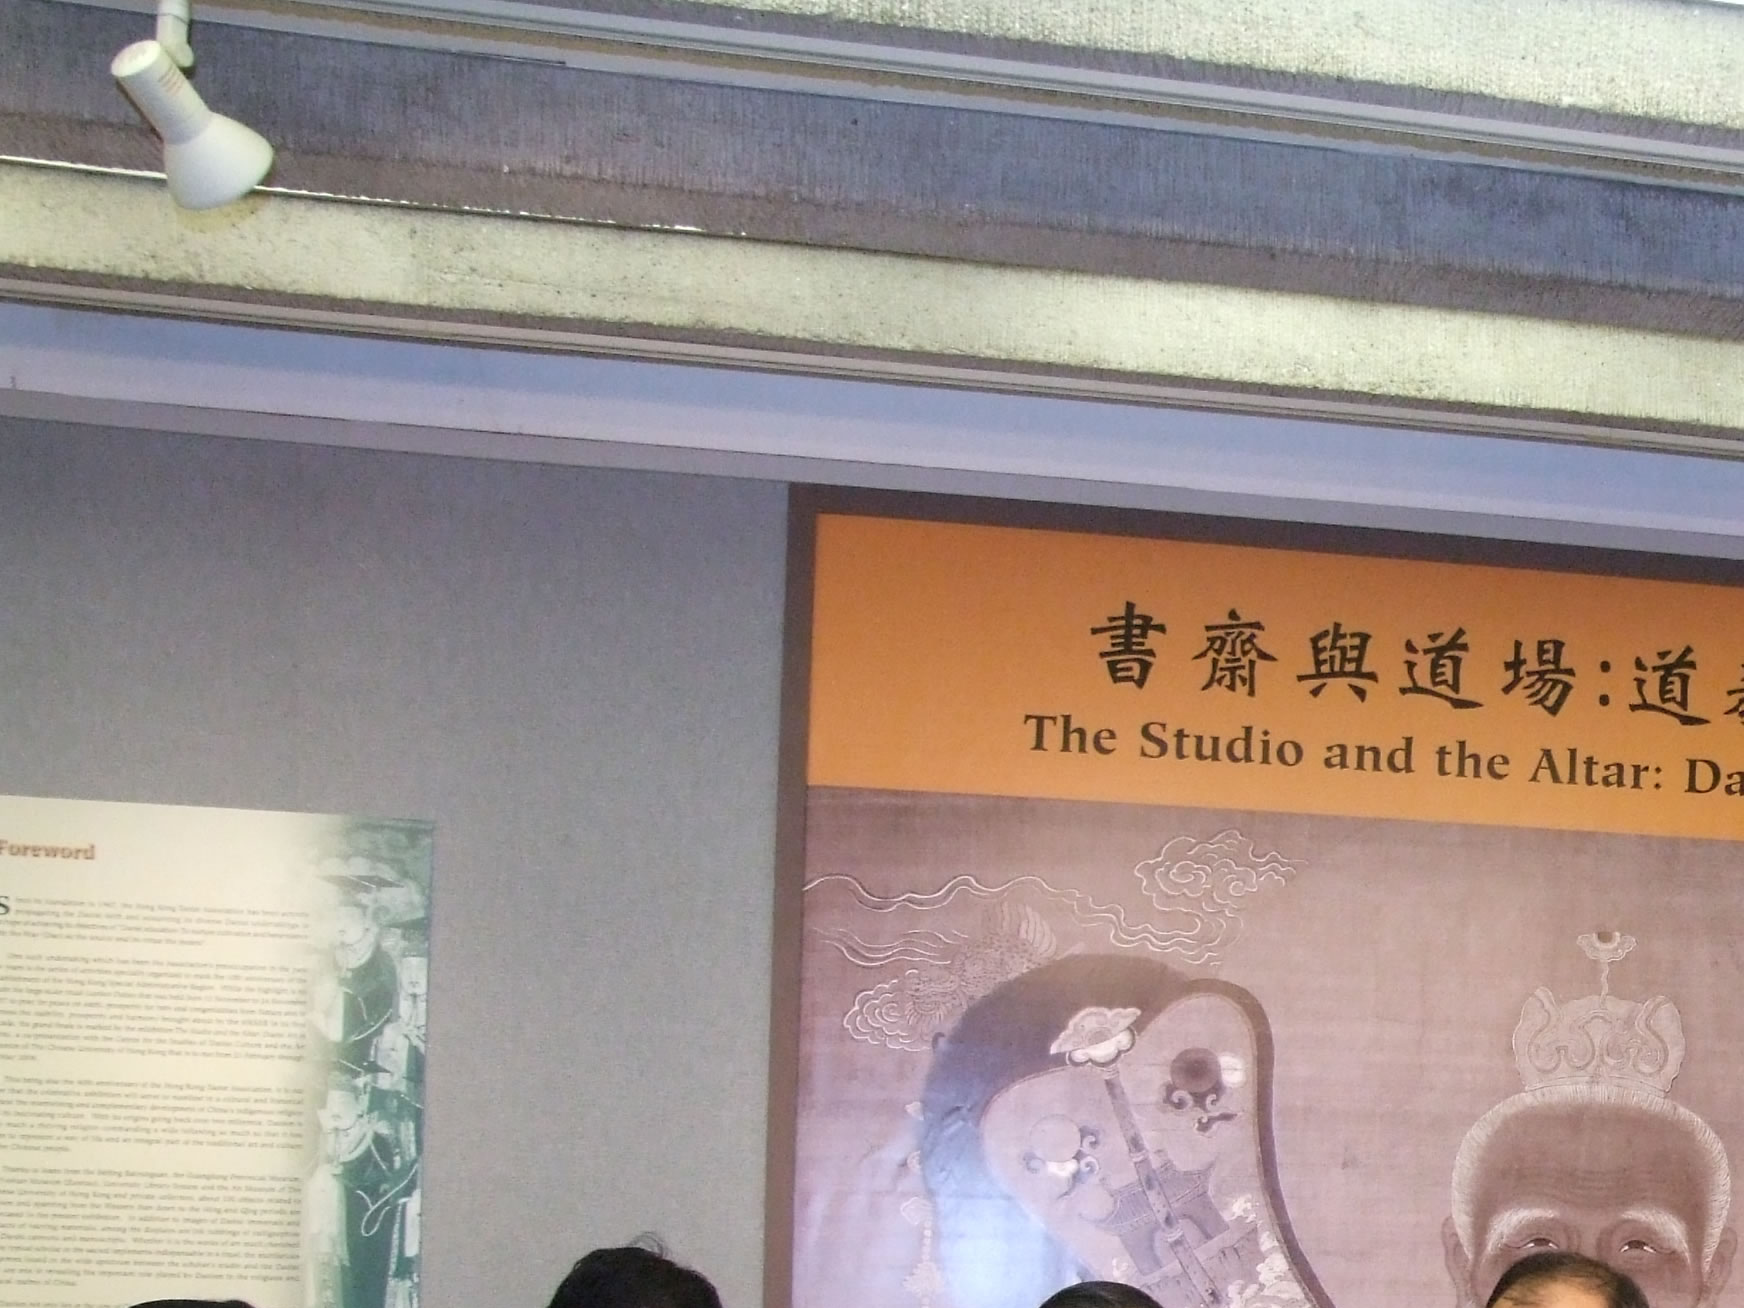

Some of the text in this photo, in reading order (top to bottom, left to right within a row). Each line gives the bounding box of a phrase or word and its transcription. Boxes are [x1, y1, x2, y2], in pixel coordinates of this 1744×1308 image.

[1023, 714, 1117, 757] The
[1140, 721, 1304, 768] Studio
[1323, 736, 1415, 774] and
[1435, 740, 1510, 781] the
[1528, 748, 1664, 790] Altar:
